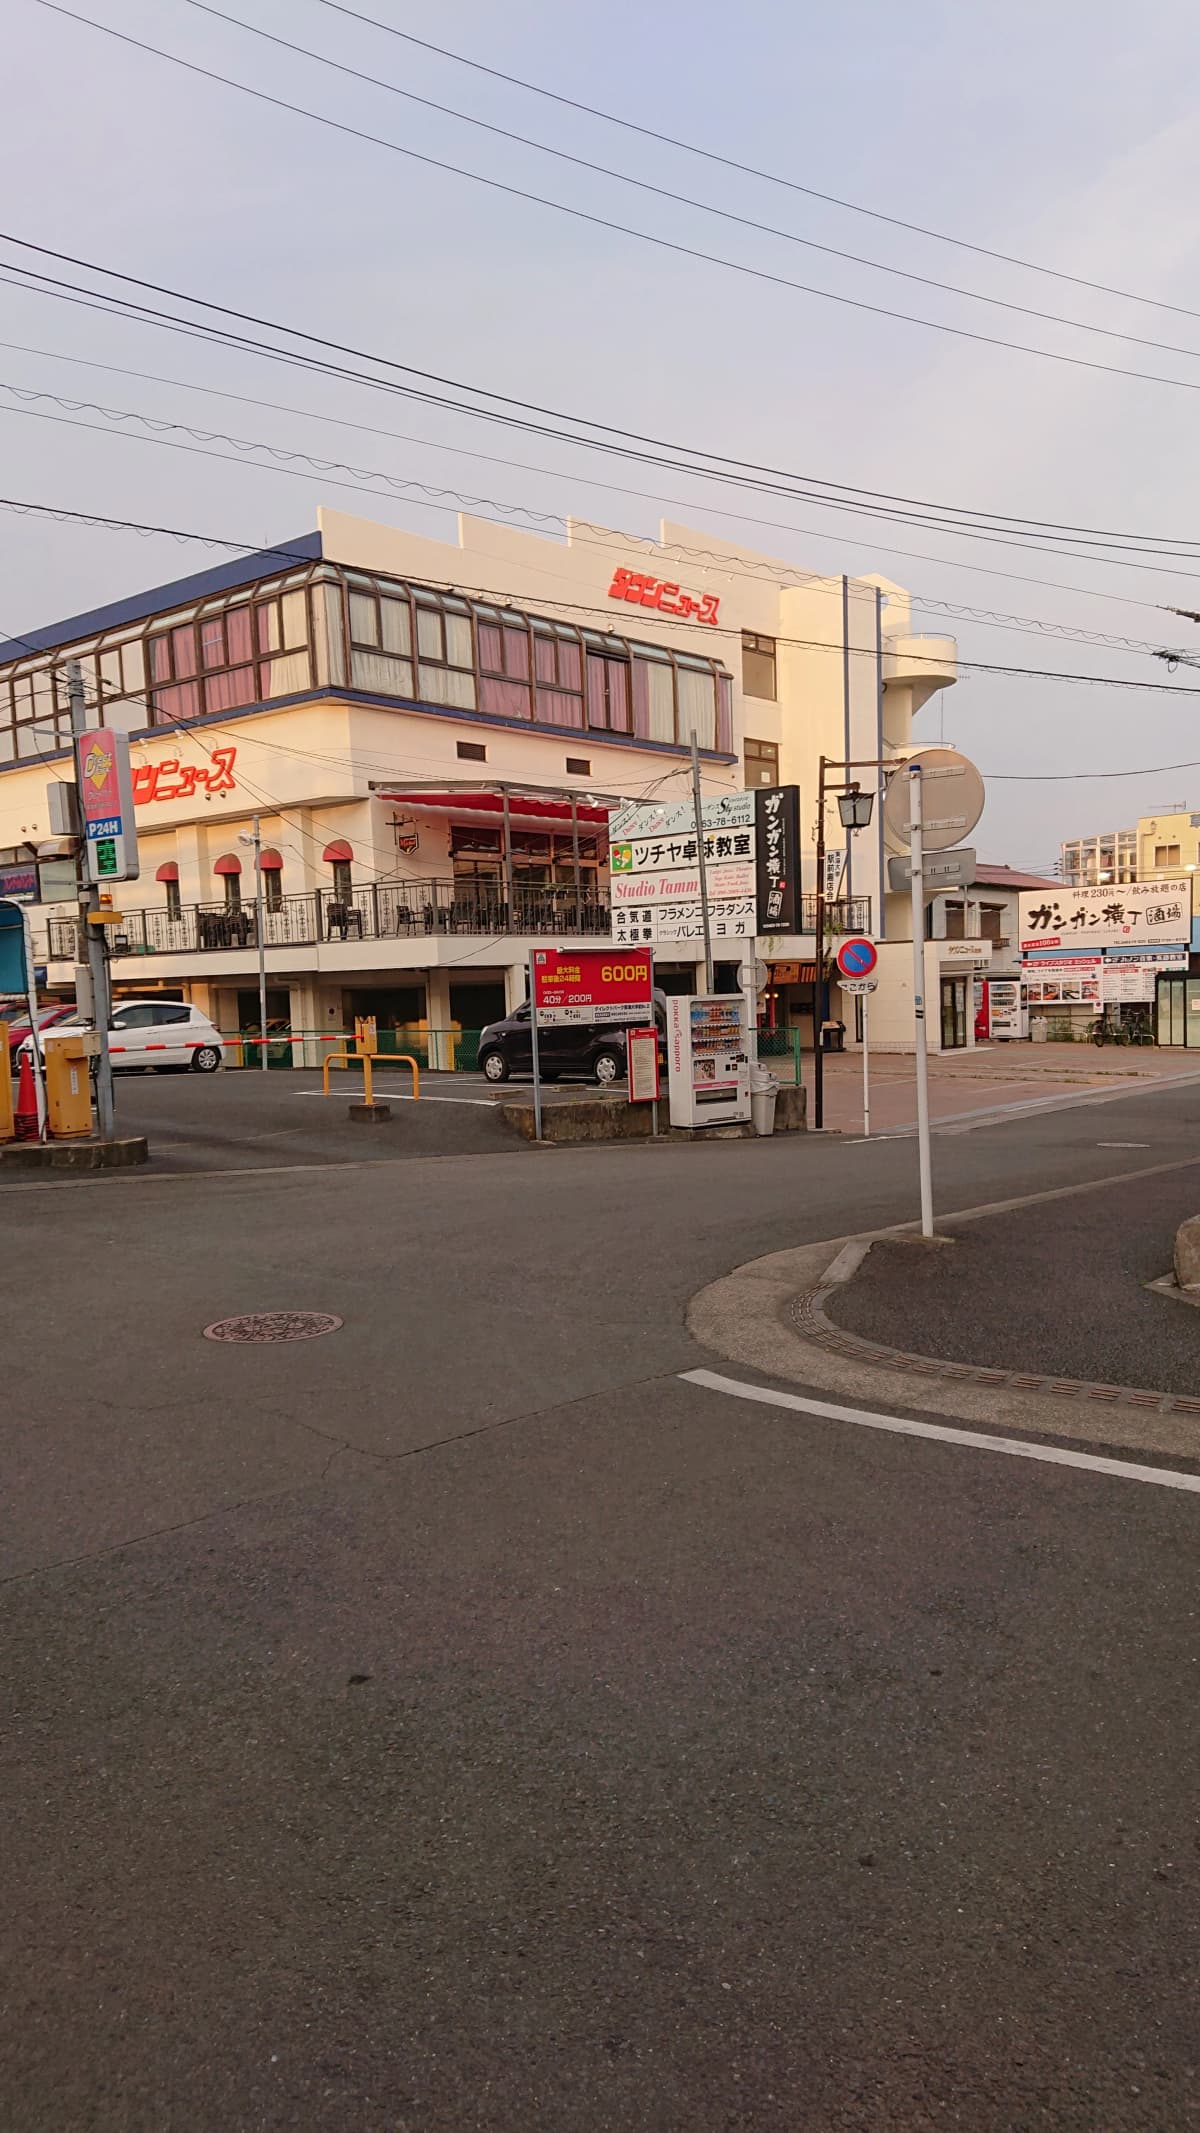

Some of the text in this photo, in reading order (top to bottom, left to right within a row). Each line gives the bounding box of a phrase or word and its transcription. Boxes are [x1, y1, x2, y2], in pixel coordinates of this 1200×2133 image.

[608, 567, 720, 625] タウンニュース
[131, 747, 237, 805] ンニュース
[690, 815, 751, 829] 063-78-6112
[635, 834, 751, 866] ツチヤ卓球教室
[765, 792, 784, 888] ガンガン横丁
[615, 878, 704, 898] Studio Tamm
[617, 910, 652, 924] 合気道
[1027, 902, 1143, 931] ガンガン横丁
[601, 965, 648, 982] 600円
[842, 983, 876, 992] ここから
